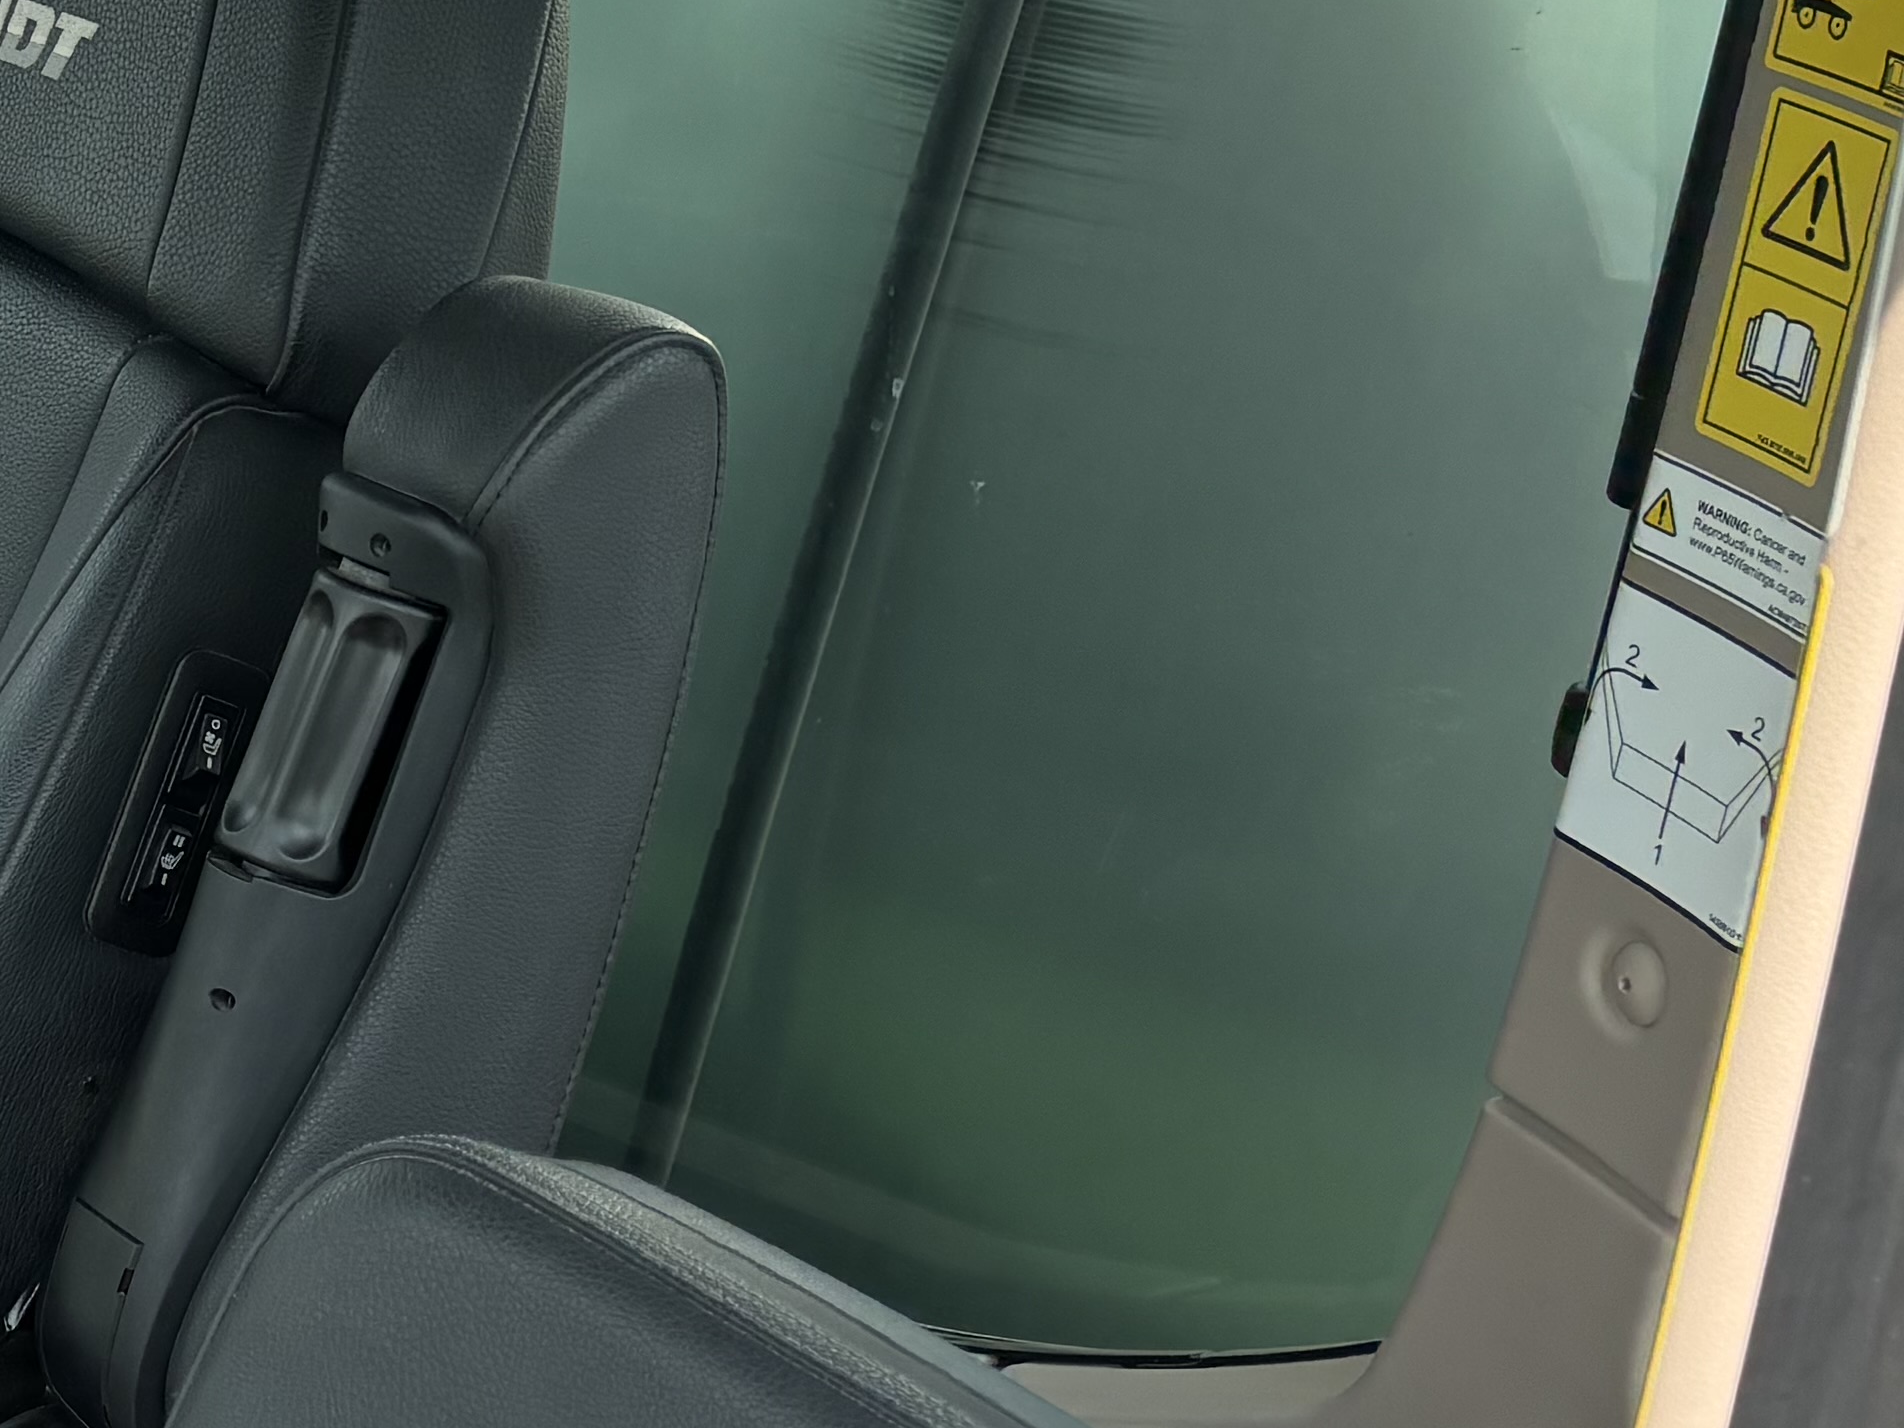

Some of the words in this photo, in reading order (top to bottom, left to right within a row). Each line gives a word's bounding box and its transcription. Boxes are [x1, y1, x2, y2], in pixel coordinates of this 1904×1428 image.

[1697, 500, 1752, 536] WARNING:
[1788, 549, 1807, 566] and
[1625, 644, 1641, 668] 2
[1750, 716, 1766, 742] 2
[1653, 843, 1663, 866] 1
